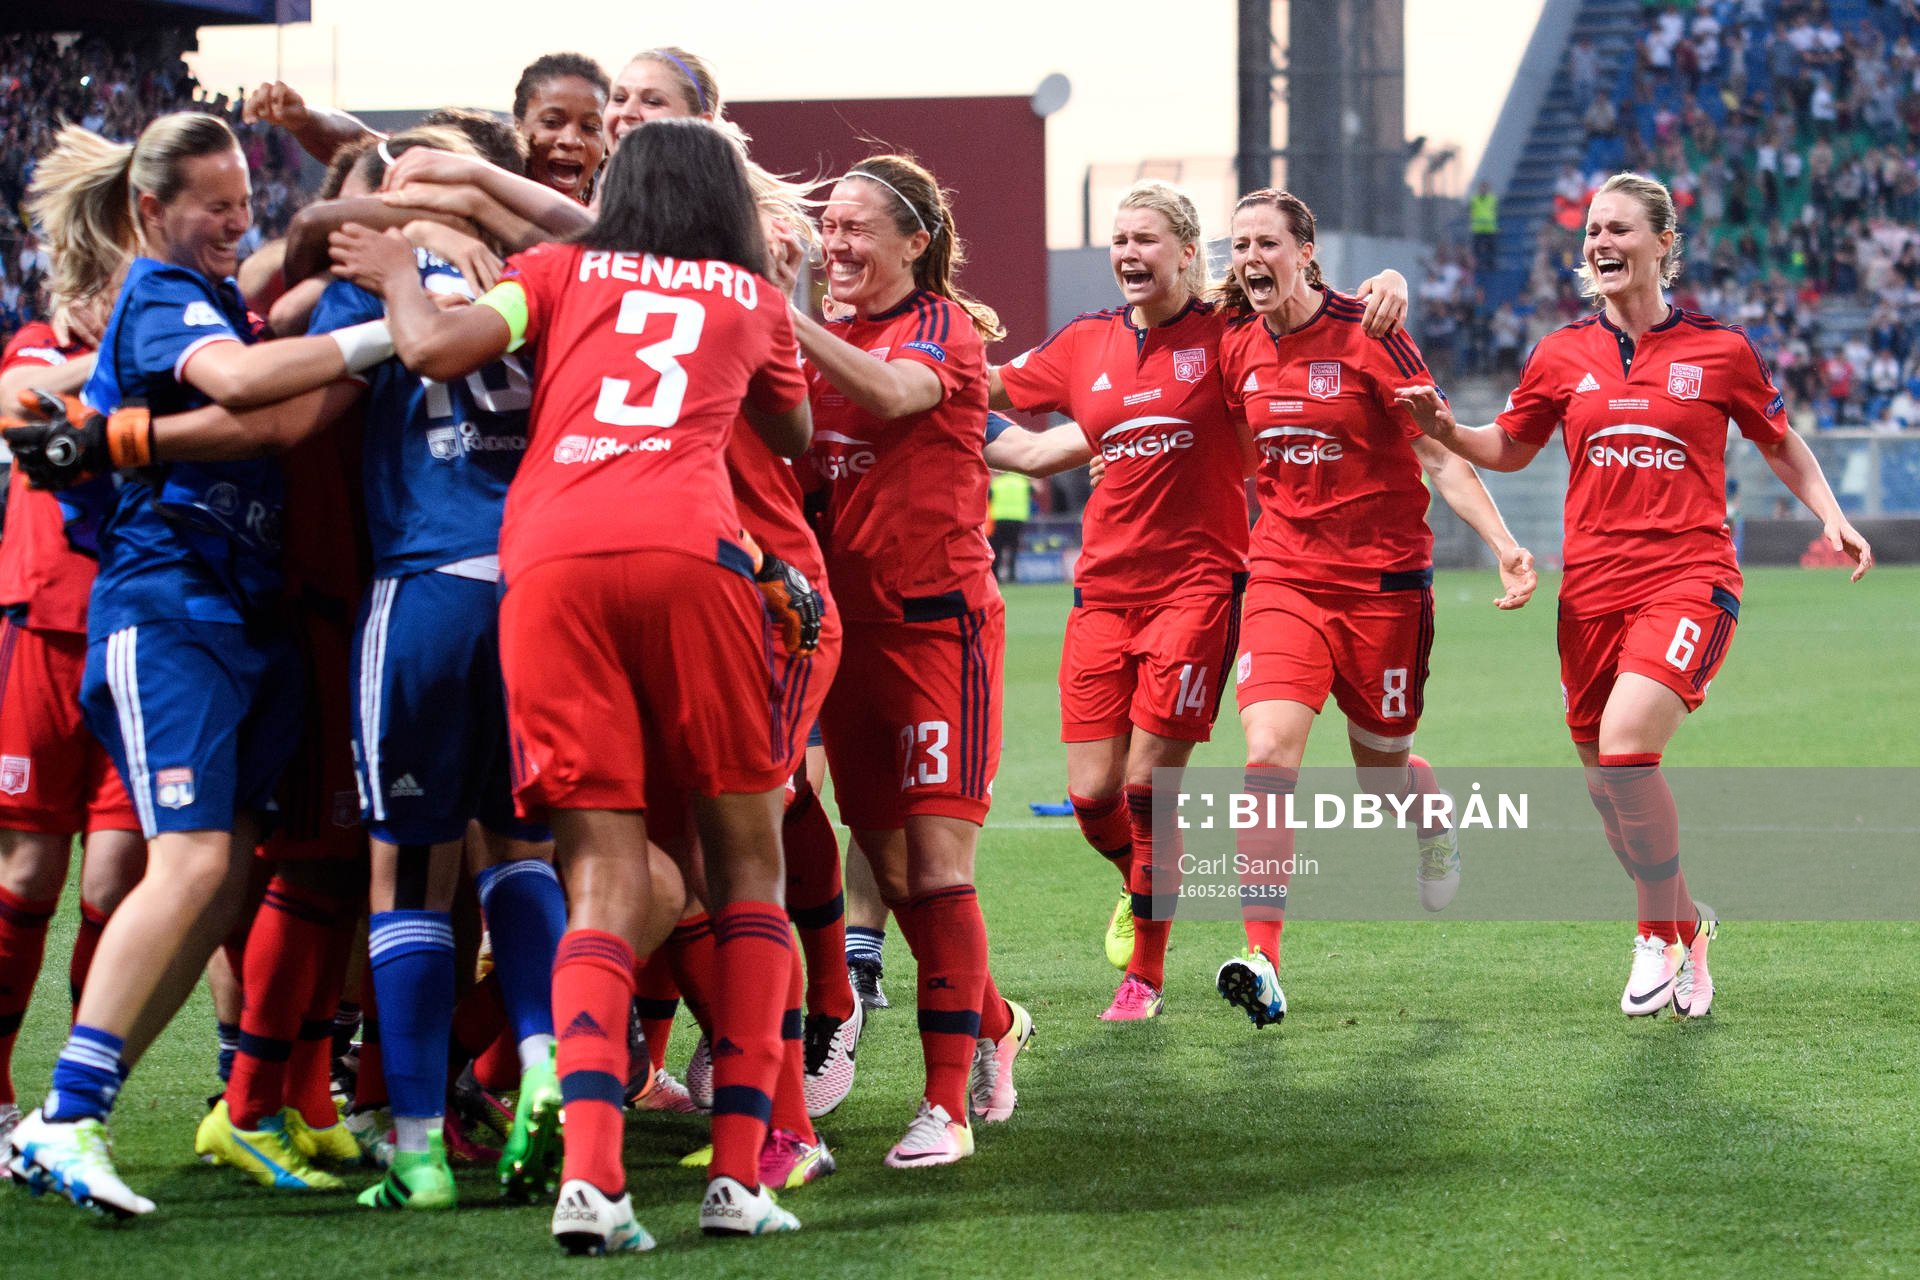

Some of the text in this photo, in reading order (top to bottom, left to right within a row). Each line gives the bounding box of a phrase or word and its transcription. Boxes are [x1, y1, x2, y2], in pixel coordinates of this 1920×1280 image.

[579, 250, 757, 310] RENARD
[594, 290, 705, 428] 3
[907, 341, 944, 361] RESPEC
[1665, 616, 1702, 671] 6
[1175, 664, 1208, 716] 14
[1381, 668, 1407, 718] 8
[901, 720, 949, 792] 23
